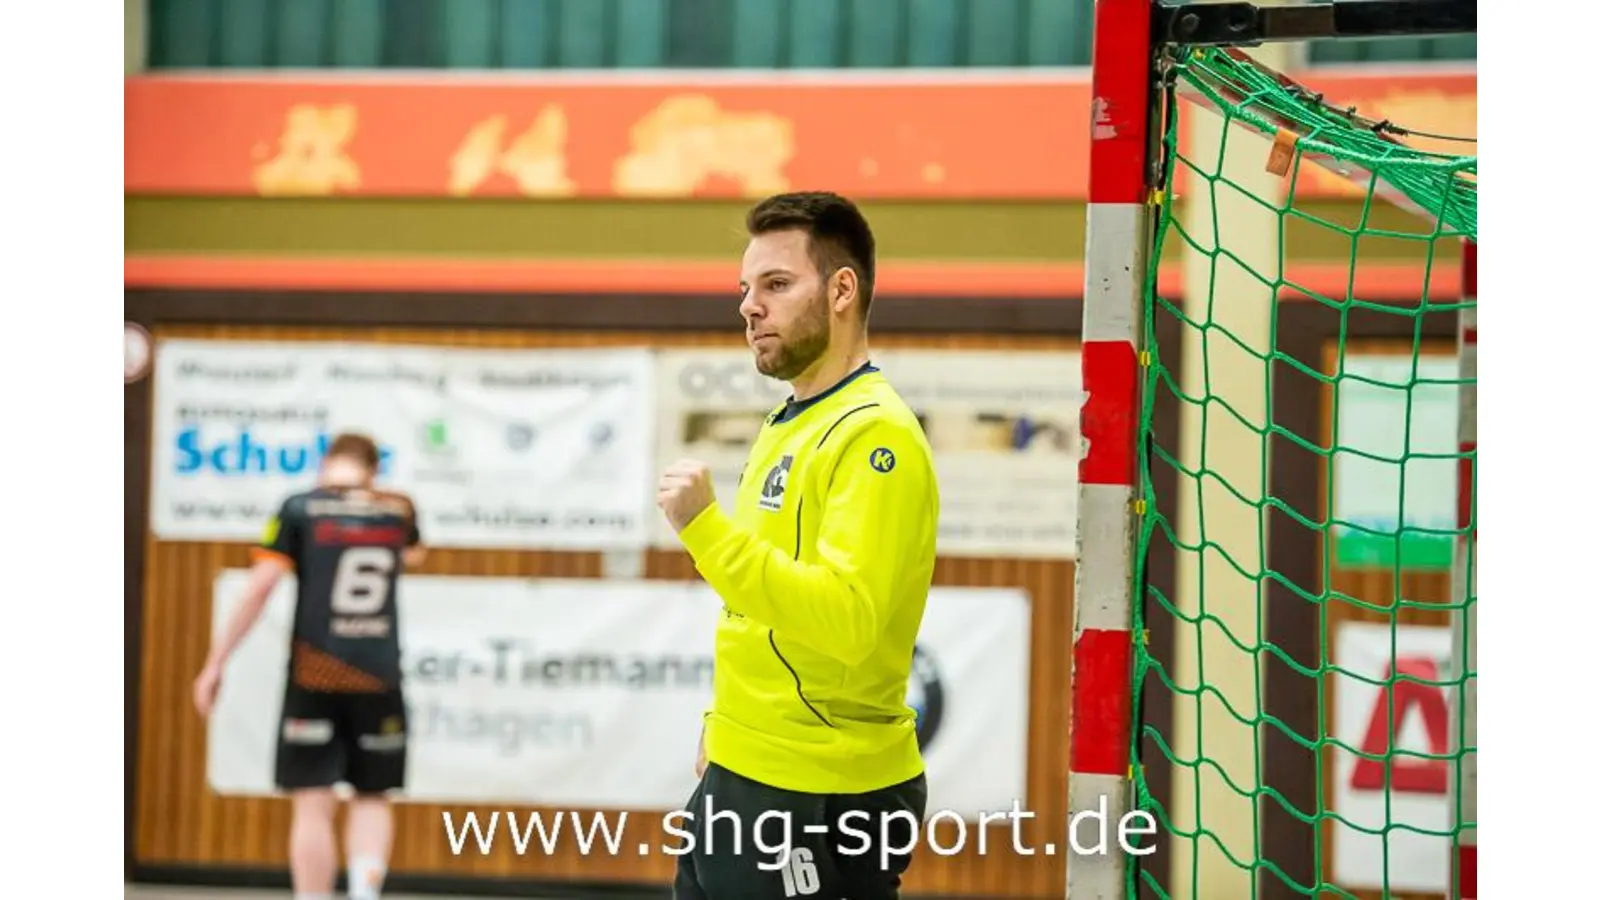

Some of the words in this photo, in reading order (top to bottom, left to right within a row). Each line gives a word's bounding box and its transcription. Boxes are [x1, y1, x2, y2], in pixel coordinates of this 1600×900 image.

[176, 428, 392, 474] Schul
[331, 546, 395, 615] 6
[776, 847, 821, 897] 16
